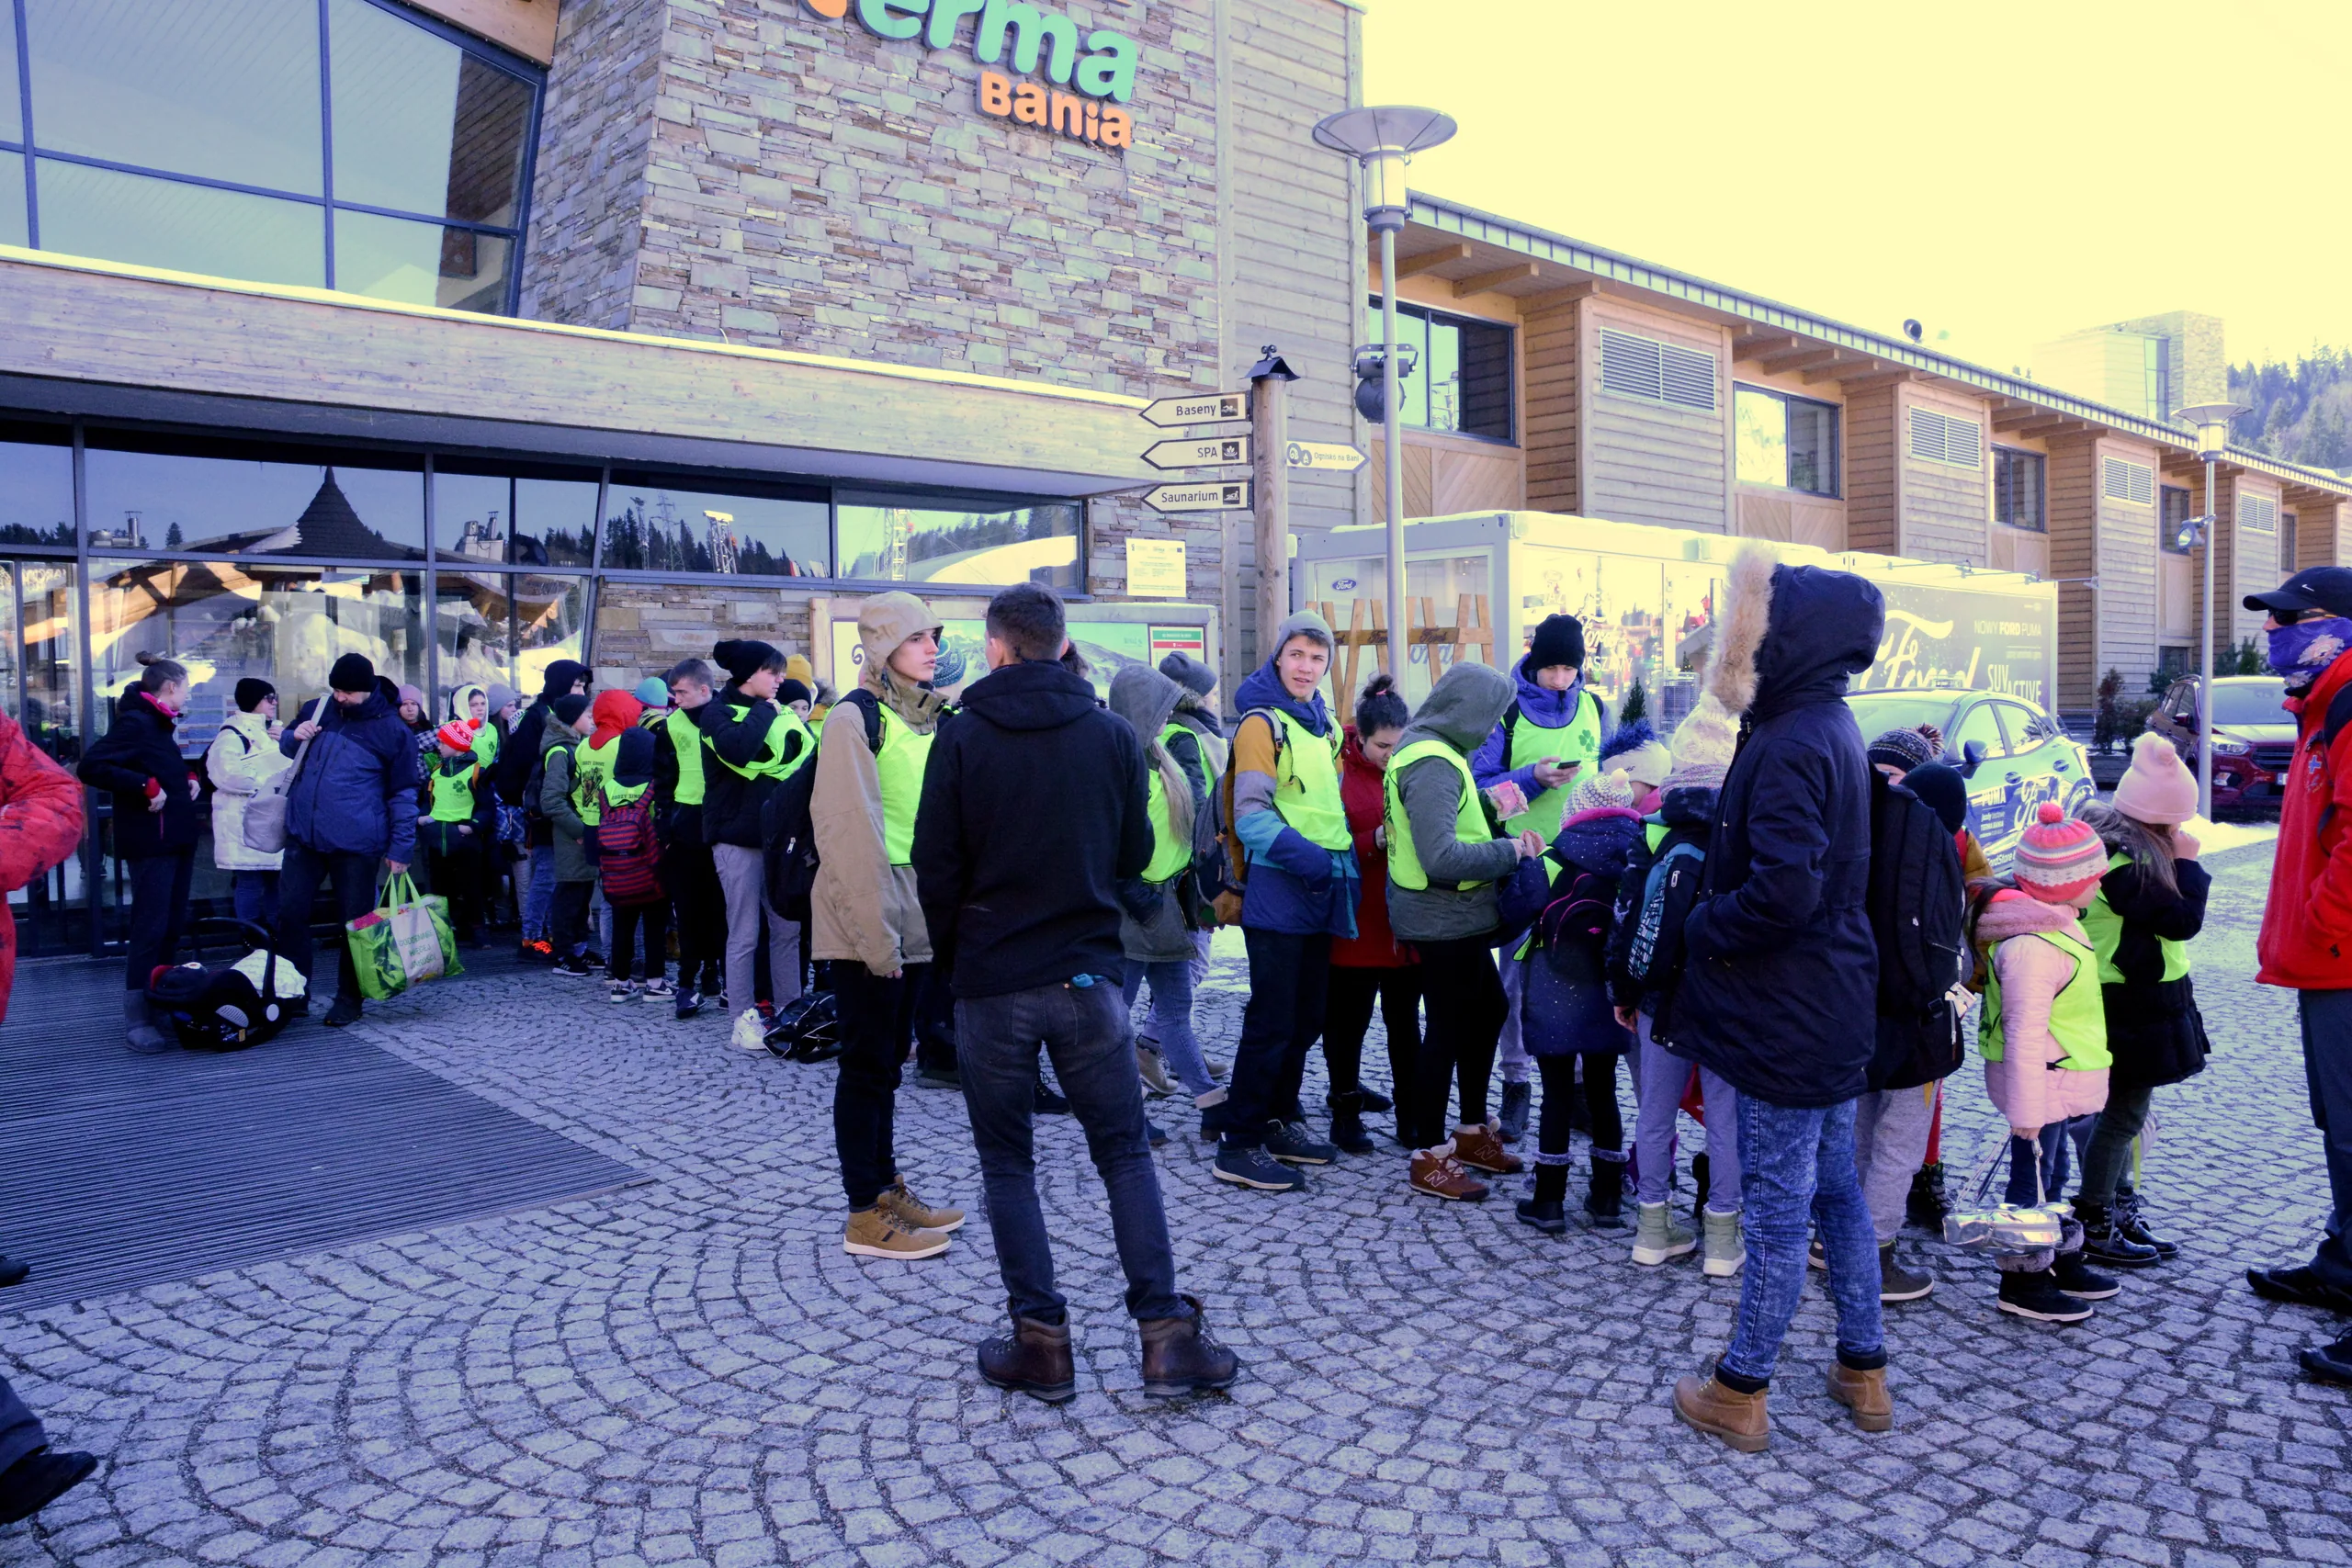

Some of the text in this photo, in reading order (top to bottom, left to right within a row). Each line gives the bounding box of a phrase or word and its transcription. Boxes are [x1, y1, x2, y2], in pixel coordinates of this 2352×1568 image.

[978, 70, 1132, 149] Bania
[1176, 404, 1216, 416] Baseny
[1197, 446, 1218, 458] SPA
[1161, 491, 1218, 502] Saunarium
[1973, 620, 2042, 637] NOWY FORD PUMA
[1987, 663, 2009, 692] SUV
